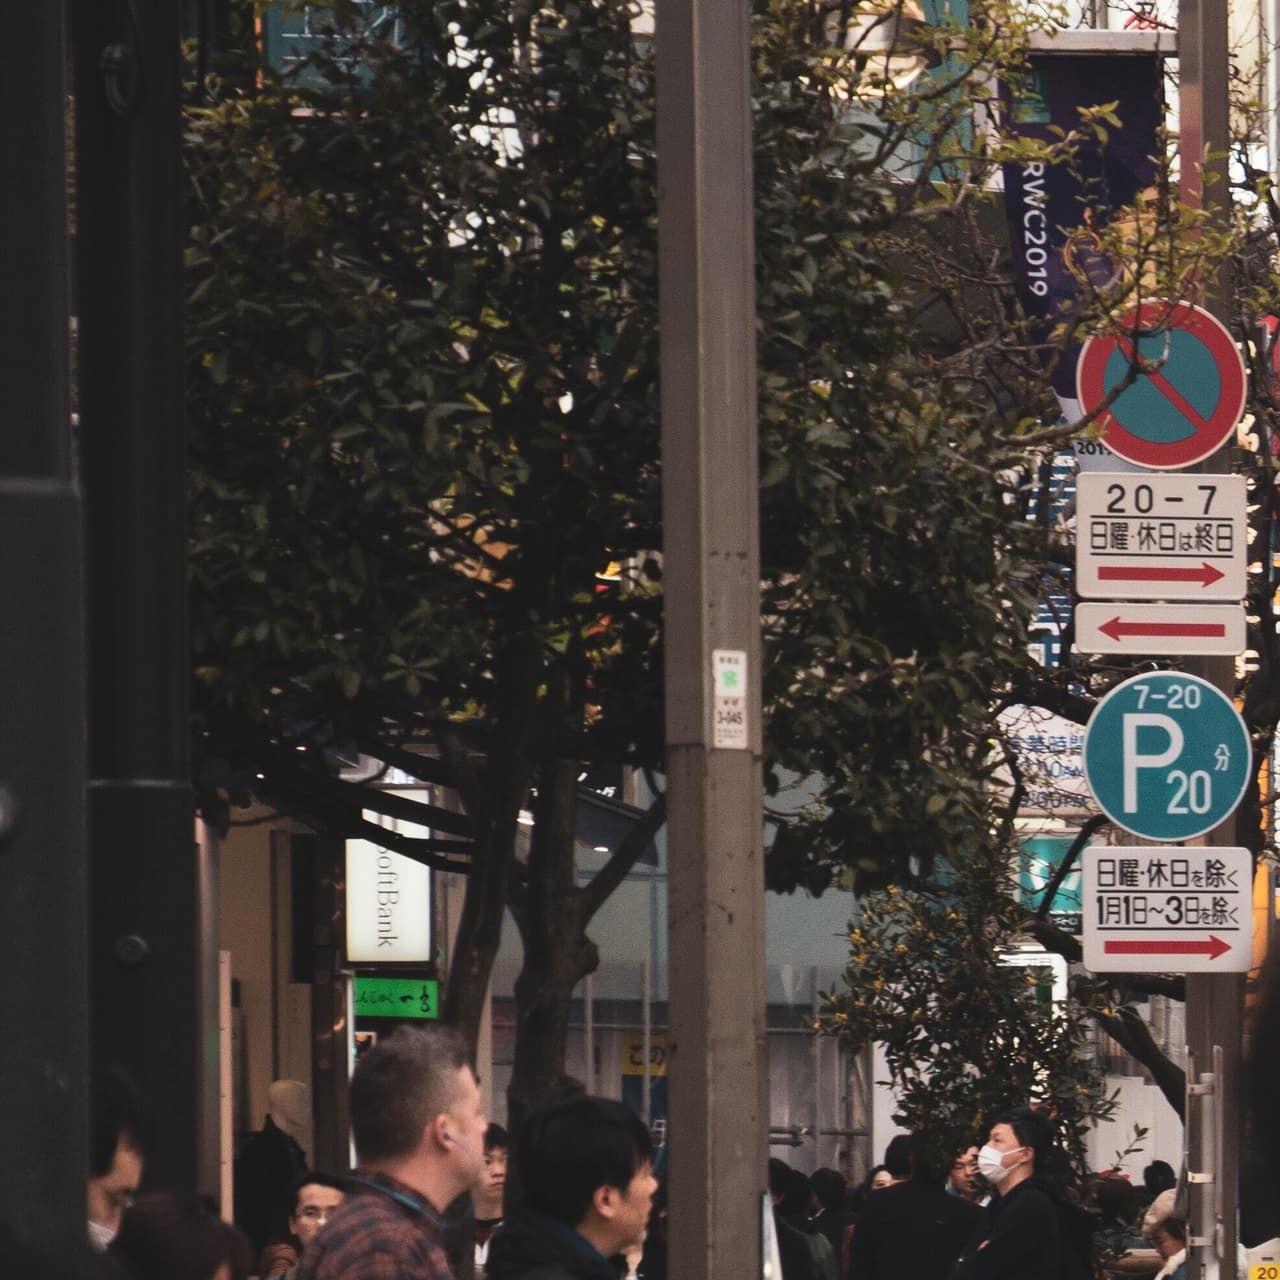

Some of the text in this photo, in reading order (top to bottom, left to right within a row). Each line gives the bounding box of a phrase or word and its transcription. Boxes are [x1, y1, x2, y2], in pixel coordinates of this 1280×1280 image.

[1022, 161, 1049, 297] RWC2019
[1090, 521, 1234, 552] 日曜・休日は終日
[1133, 684, 1201, 710] 7-20
[1122, 713, 1185, 814] P
[1214, 743, 1232, 772] 分
[1166, 770, 1212, 815] 20
[1097, 858, 1240, 889] 日曜・休日を除く
[1257, 1267, 1279, 1280] 20
